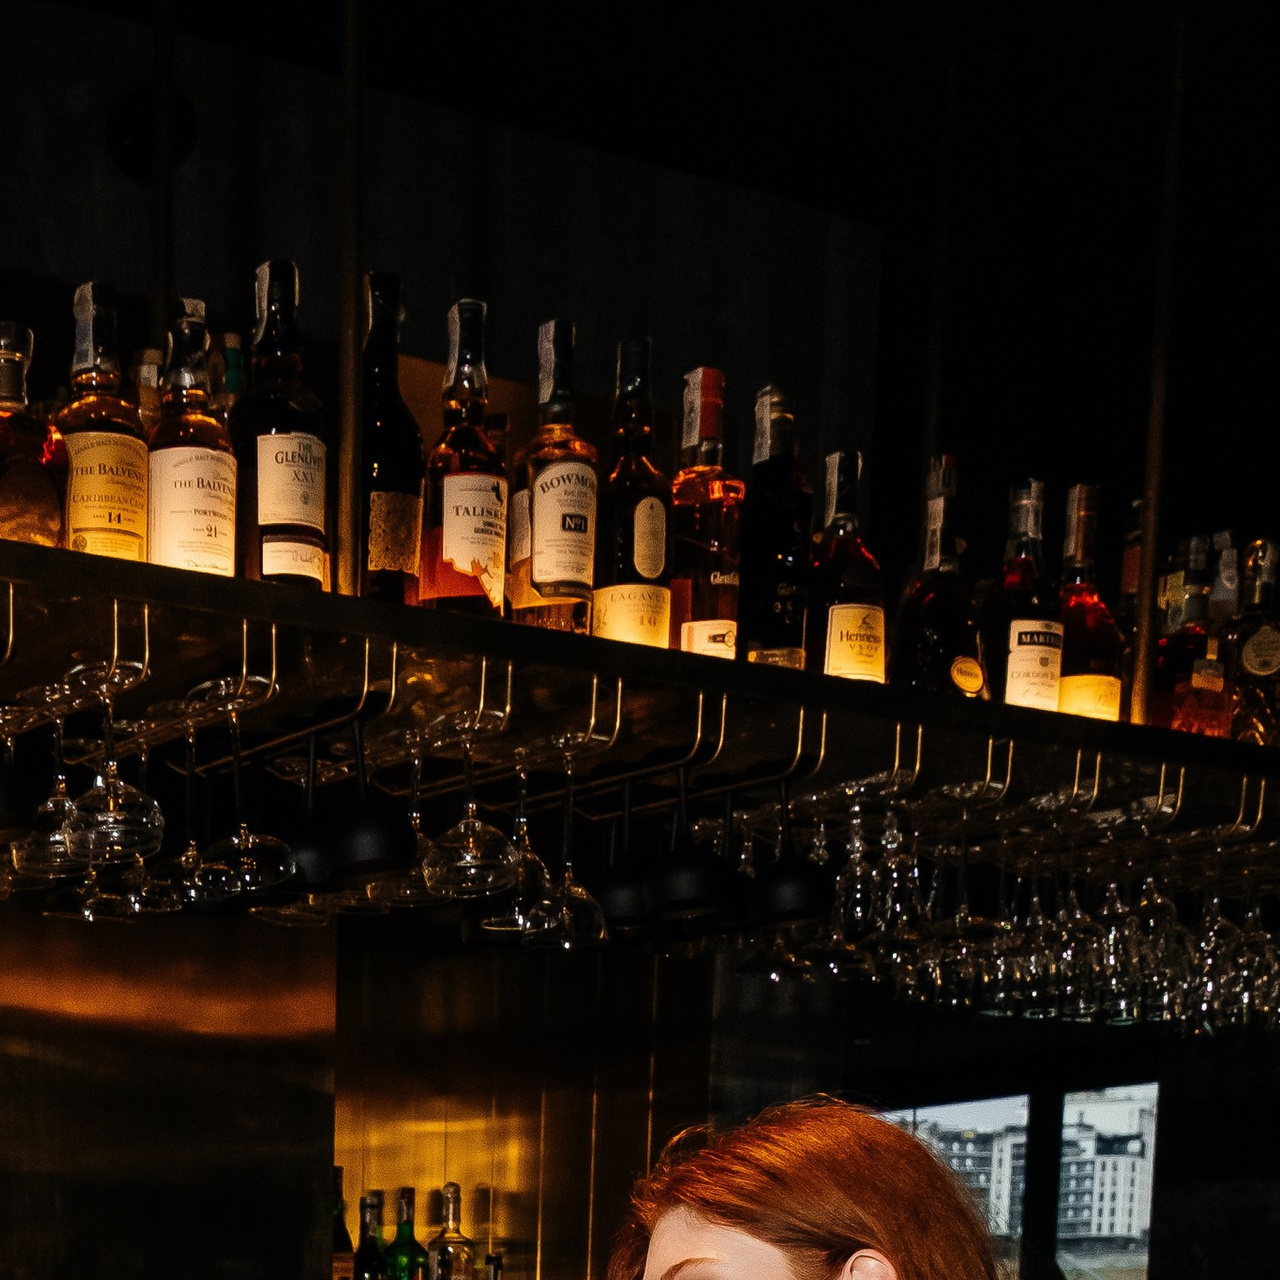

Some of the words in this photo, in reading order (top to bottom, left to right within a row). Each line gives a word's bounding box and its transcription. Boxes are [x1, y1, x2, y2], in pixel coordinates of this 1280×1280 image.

[274, 450, 323, 468] GLENLIV
[74, 466, 94, 476] THE
[196, 477, 235, 496] BALVEN
[540, 472, 596, 494] BOWMO
[108, 511, 122, 524] 14
[453, 504, 504, 521] TALISKE
[206, 523, 218, 538] 21
